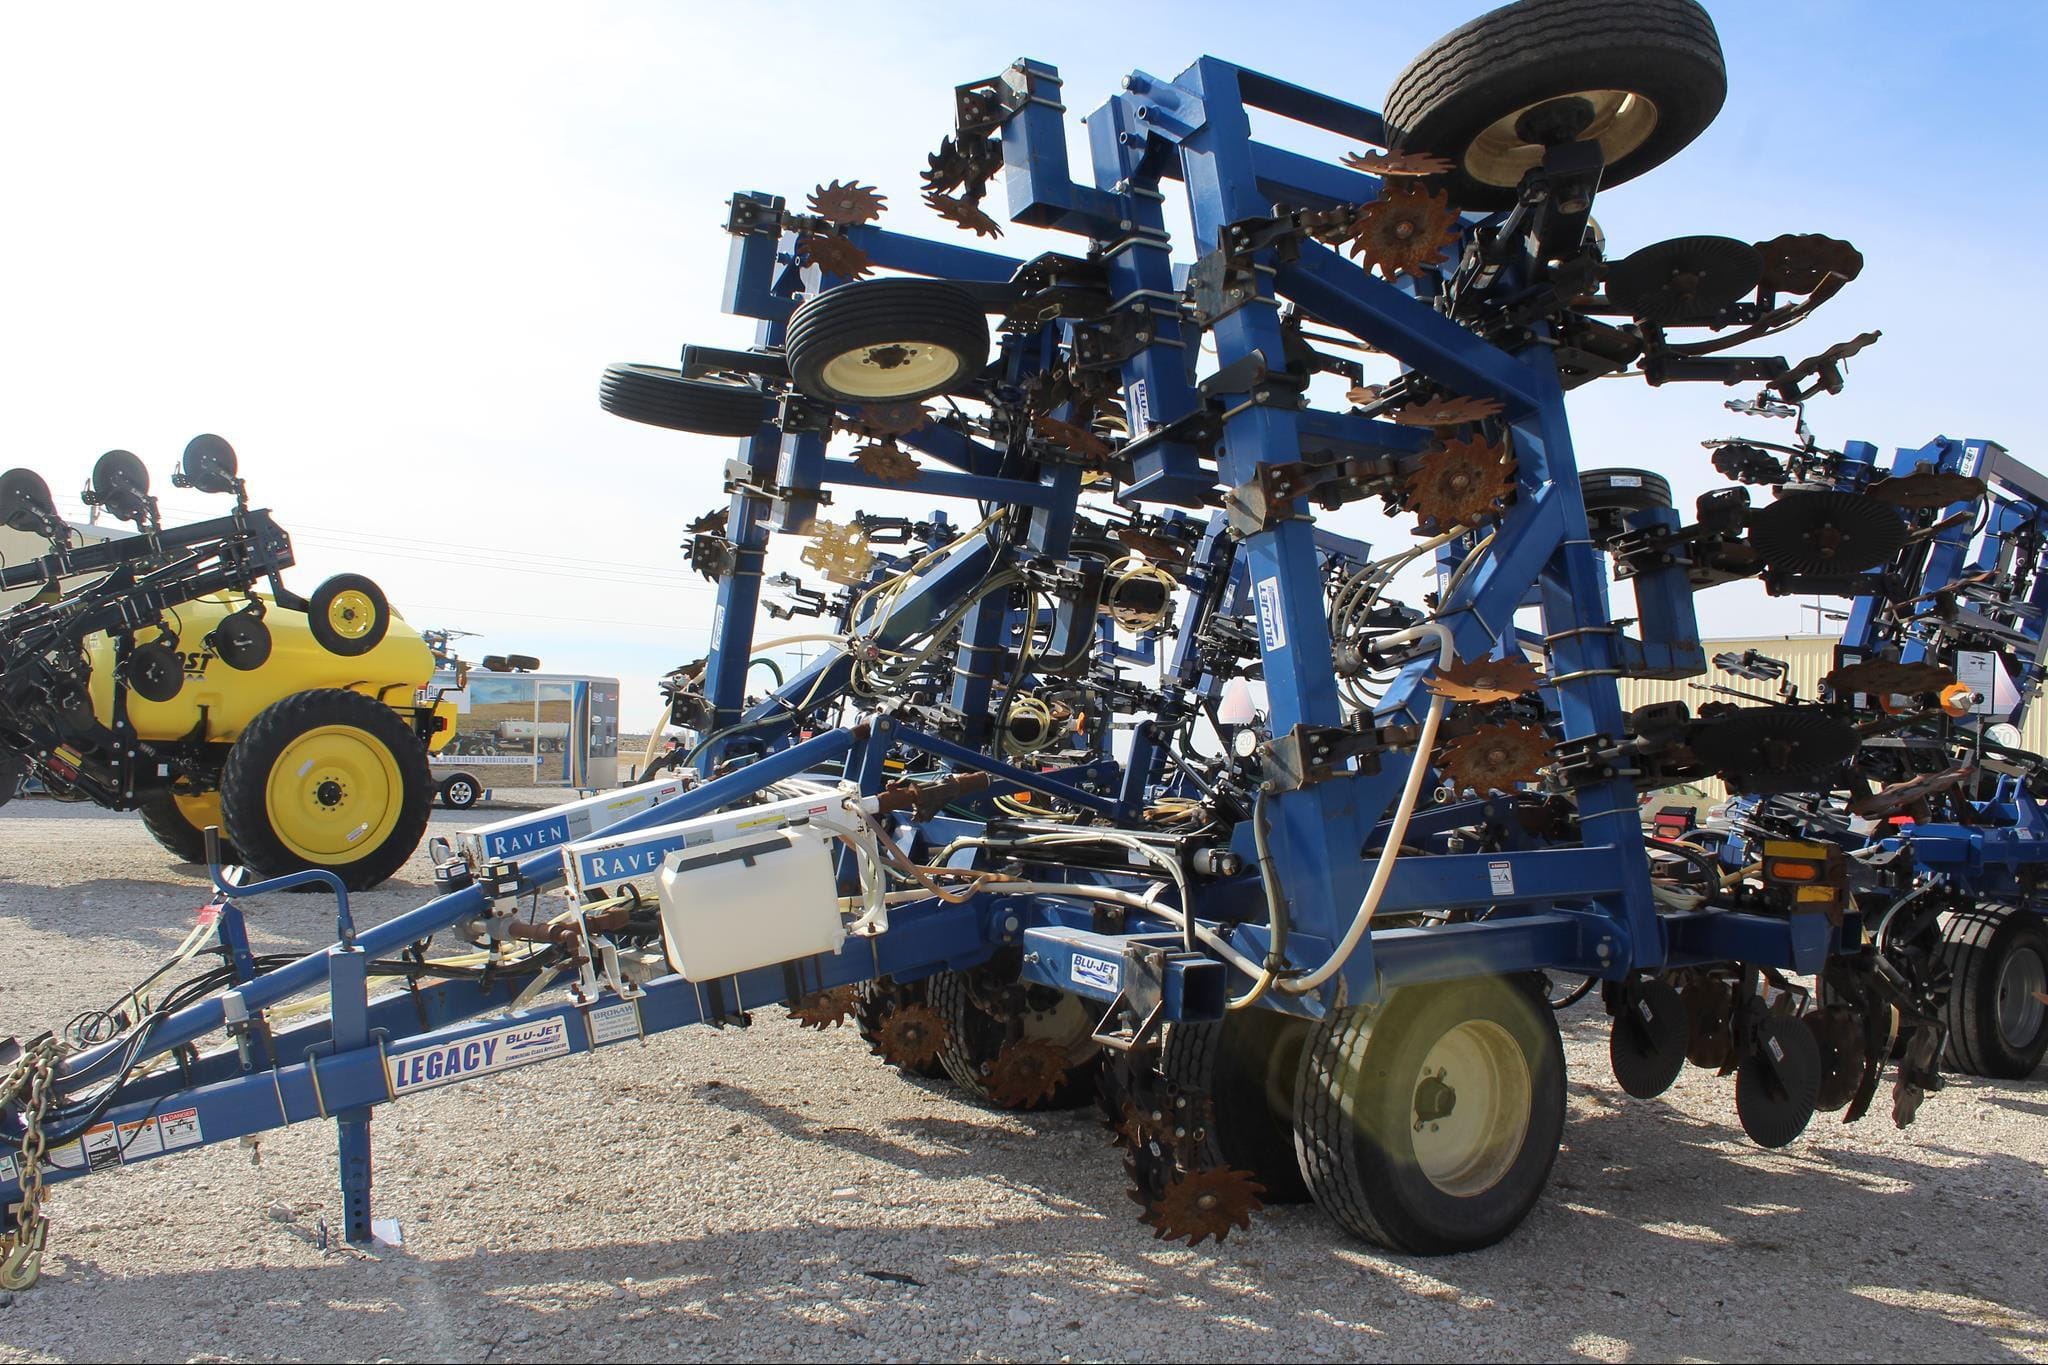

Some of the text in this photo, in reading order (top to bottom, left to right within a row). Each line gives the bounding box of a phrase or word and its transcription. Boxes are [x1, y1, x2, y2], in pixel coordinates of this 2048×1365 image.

[1260, 585, 1275, 647] BLU-JET
[1240, 734, 1252, 746] 20
[494, 825, 562, 855] RAVEN
[1074, 955, 1117, 974] BLU-JET
[593, 1003, 635, 1019] BROKAW
[505, 1023, 563, 1045] BLU-JET
[397, 1037, 499, 1088] LEGACY
